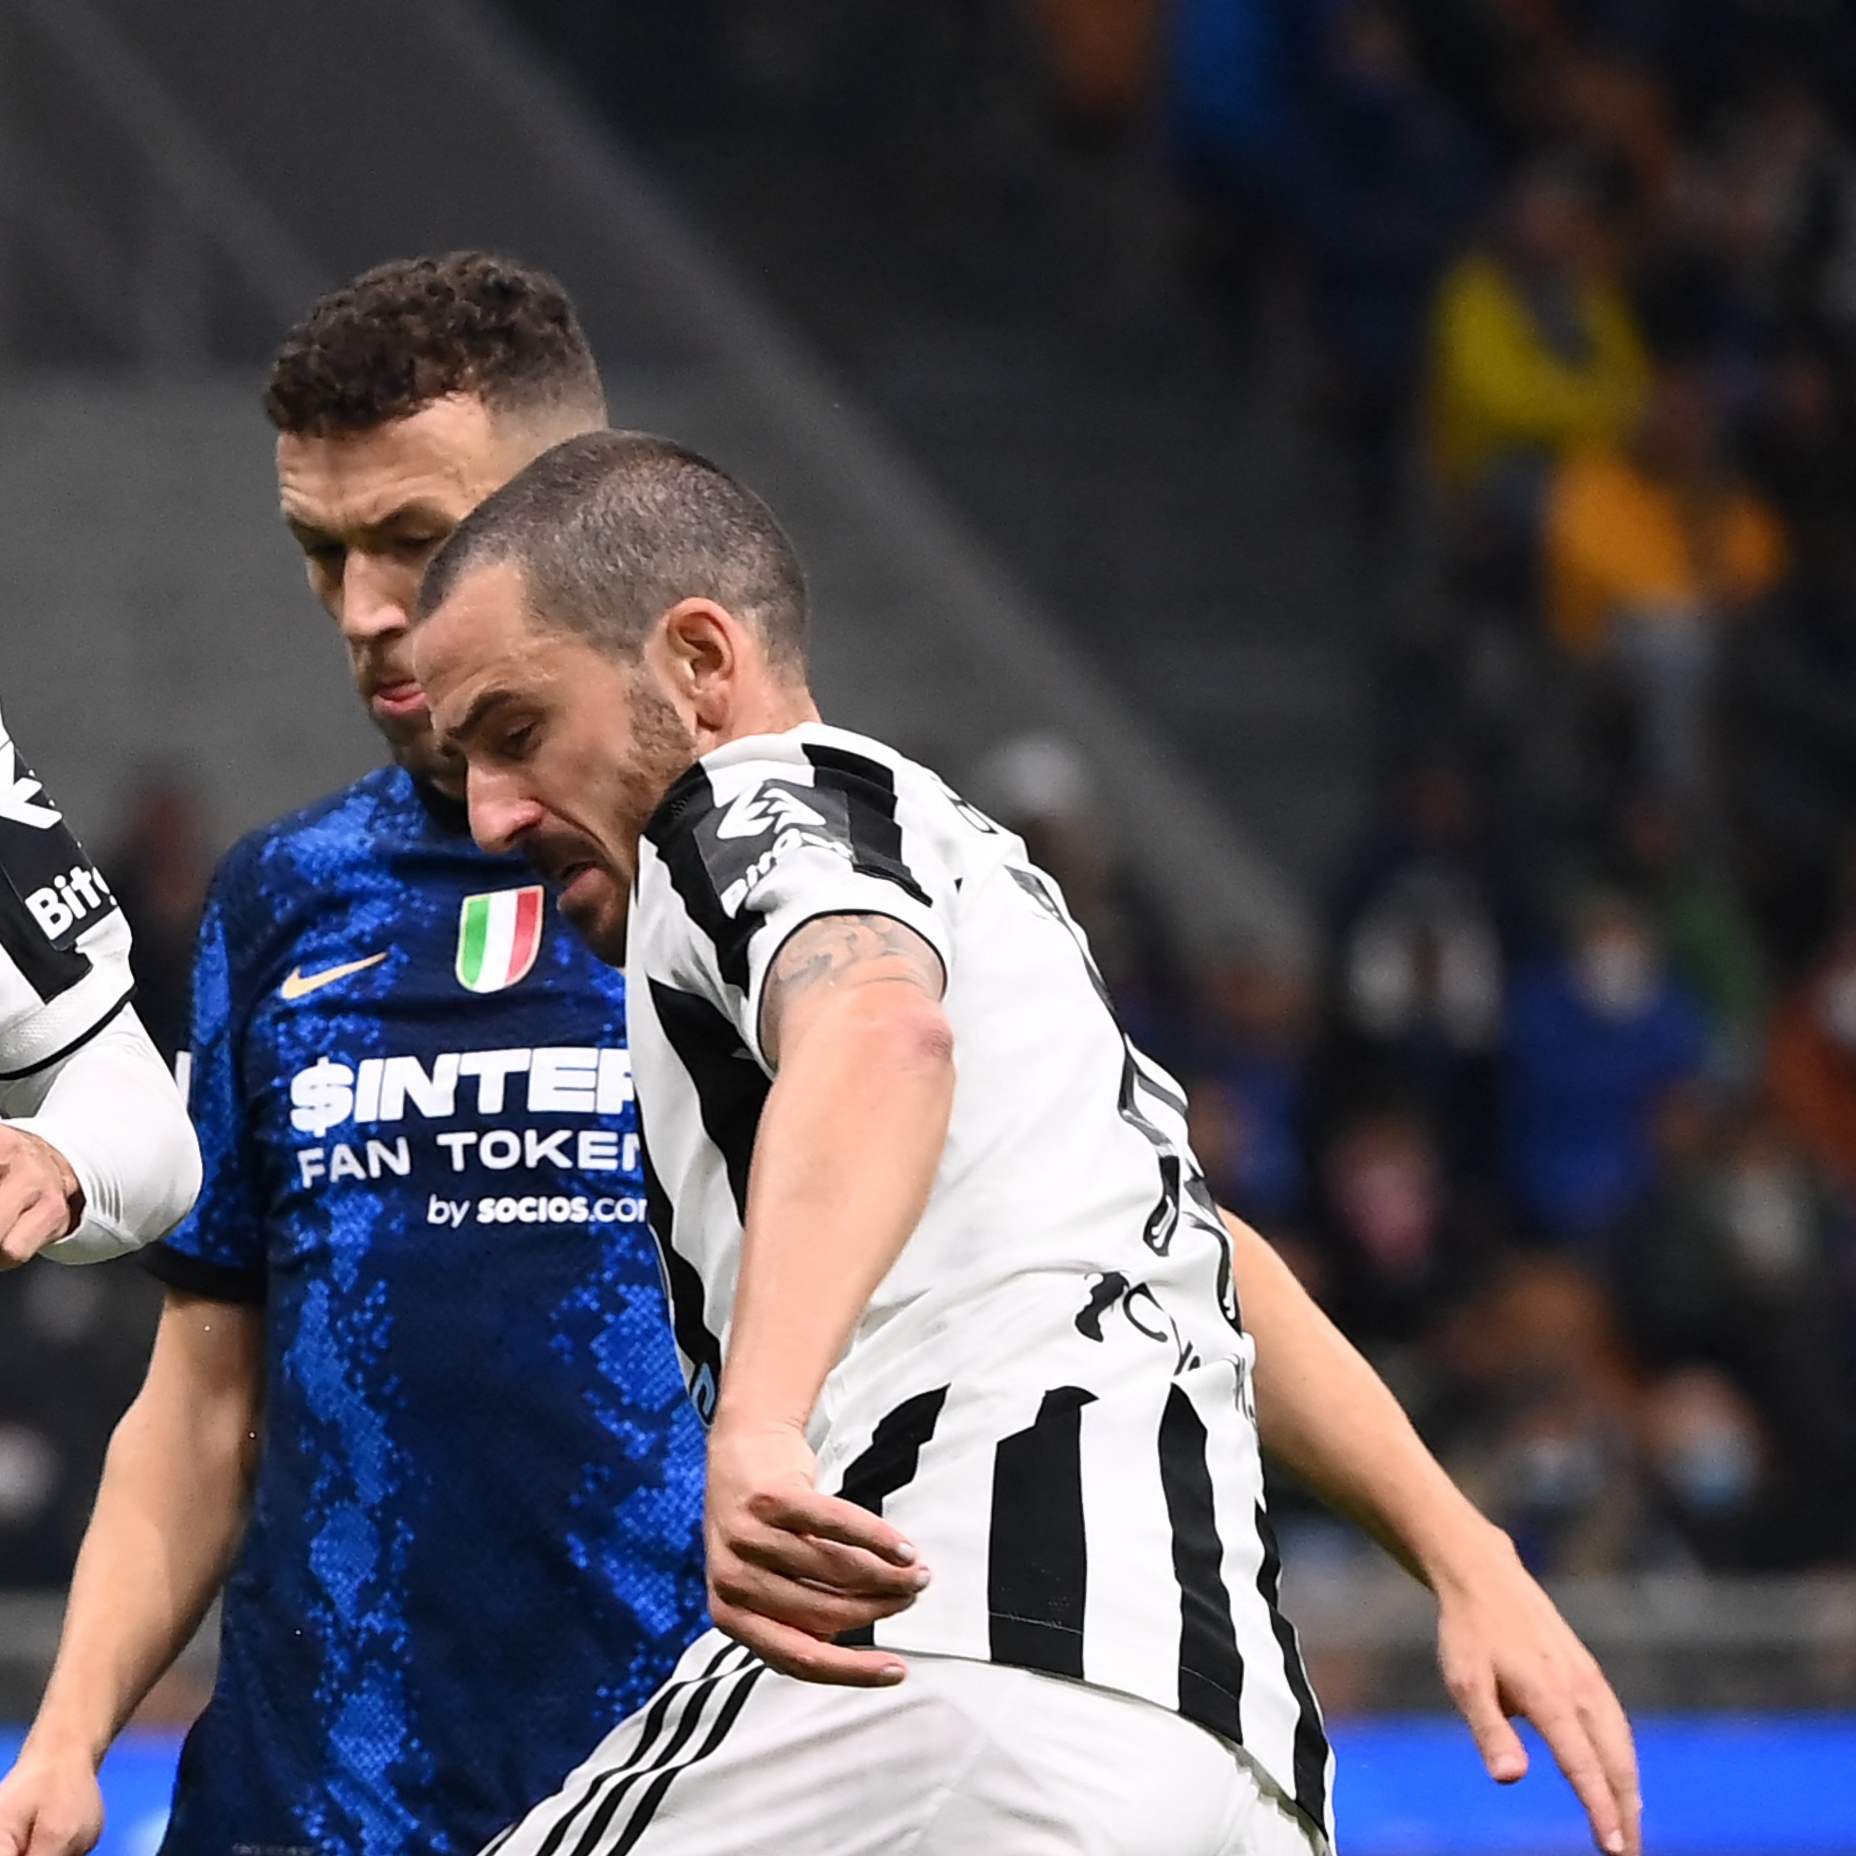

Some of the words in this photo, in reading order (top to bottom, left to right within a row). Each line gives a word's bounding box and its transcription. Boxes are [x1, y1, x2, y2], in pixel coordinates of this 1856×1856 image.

[24, 865, 118, 941] Bit
[296, 1136, 413, 1189] FAN
[427, 1194, 471, 1229] by
